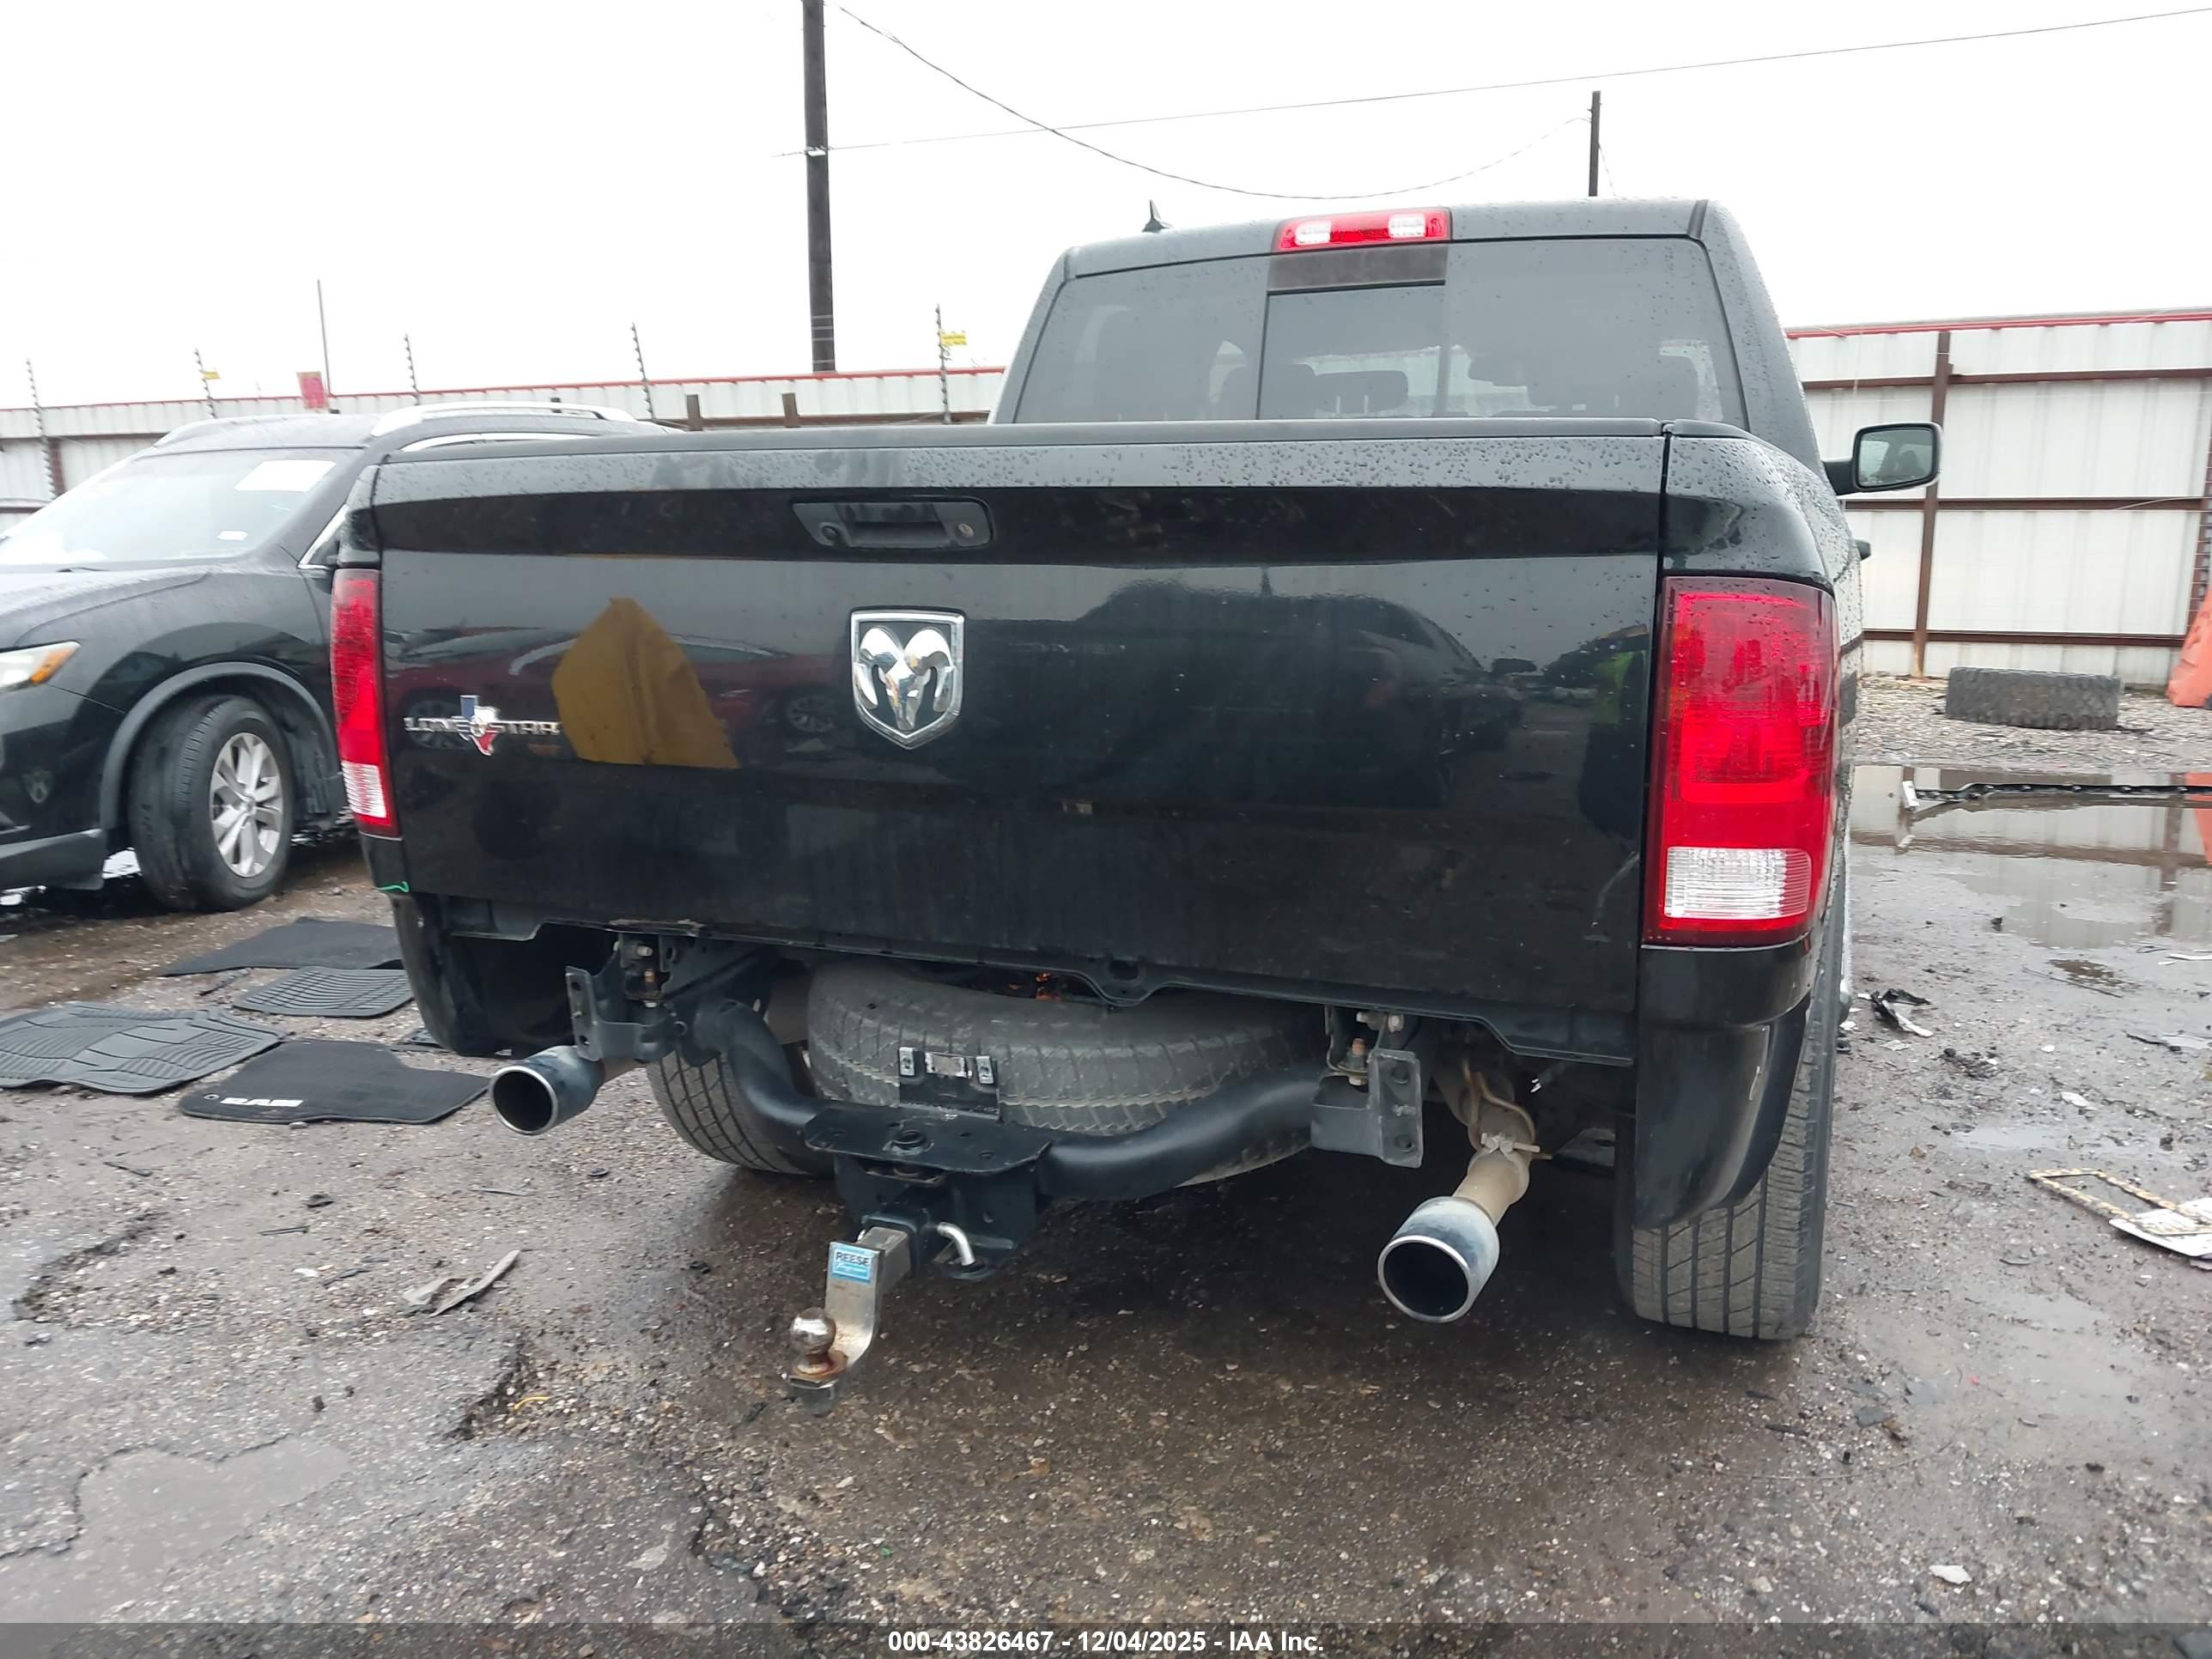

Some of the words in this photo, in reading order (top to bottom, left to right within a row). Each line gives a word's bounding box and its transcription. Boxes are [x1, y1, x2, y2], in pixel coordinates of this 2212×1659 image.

[404, 715, 471, 732] LONE
[486, 719, 562, 735] STAR
[220, 1097, 303, 1107] RAM
[836, 1251, 871, 1266] REESE
